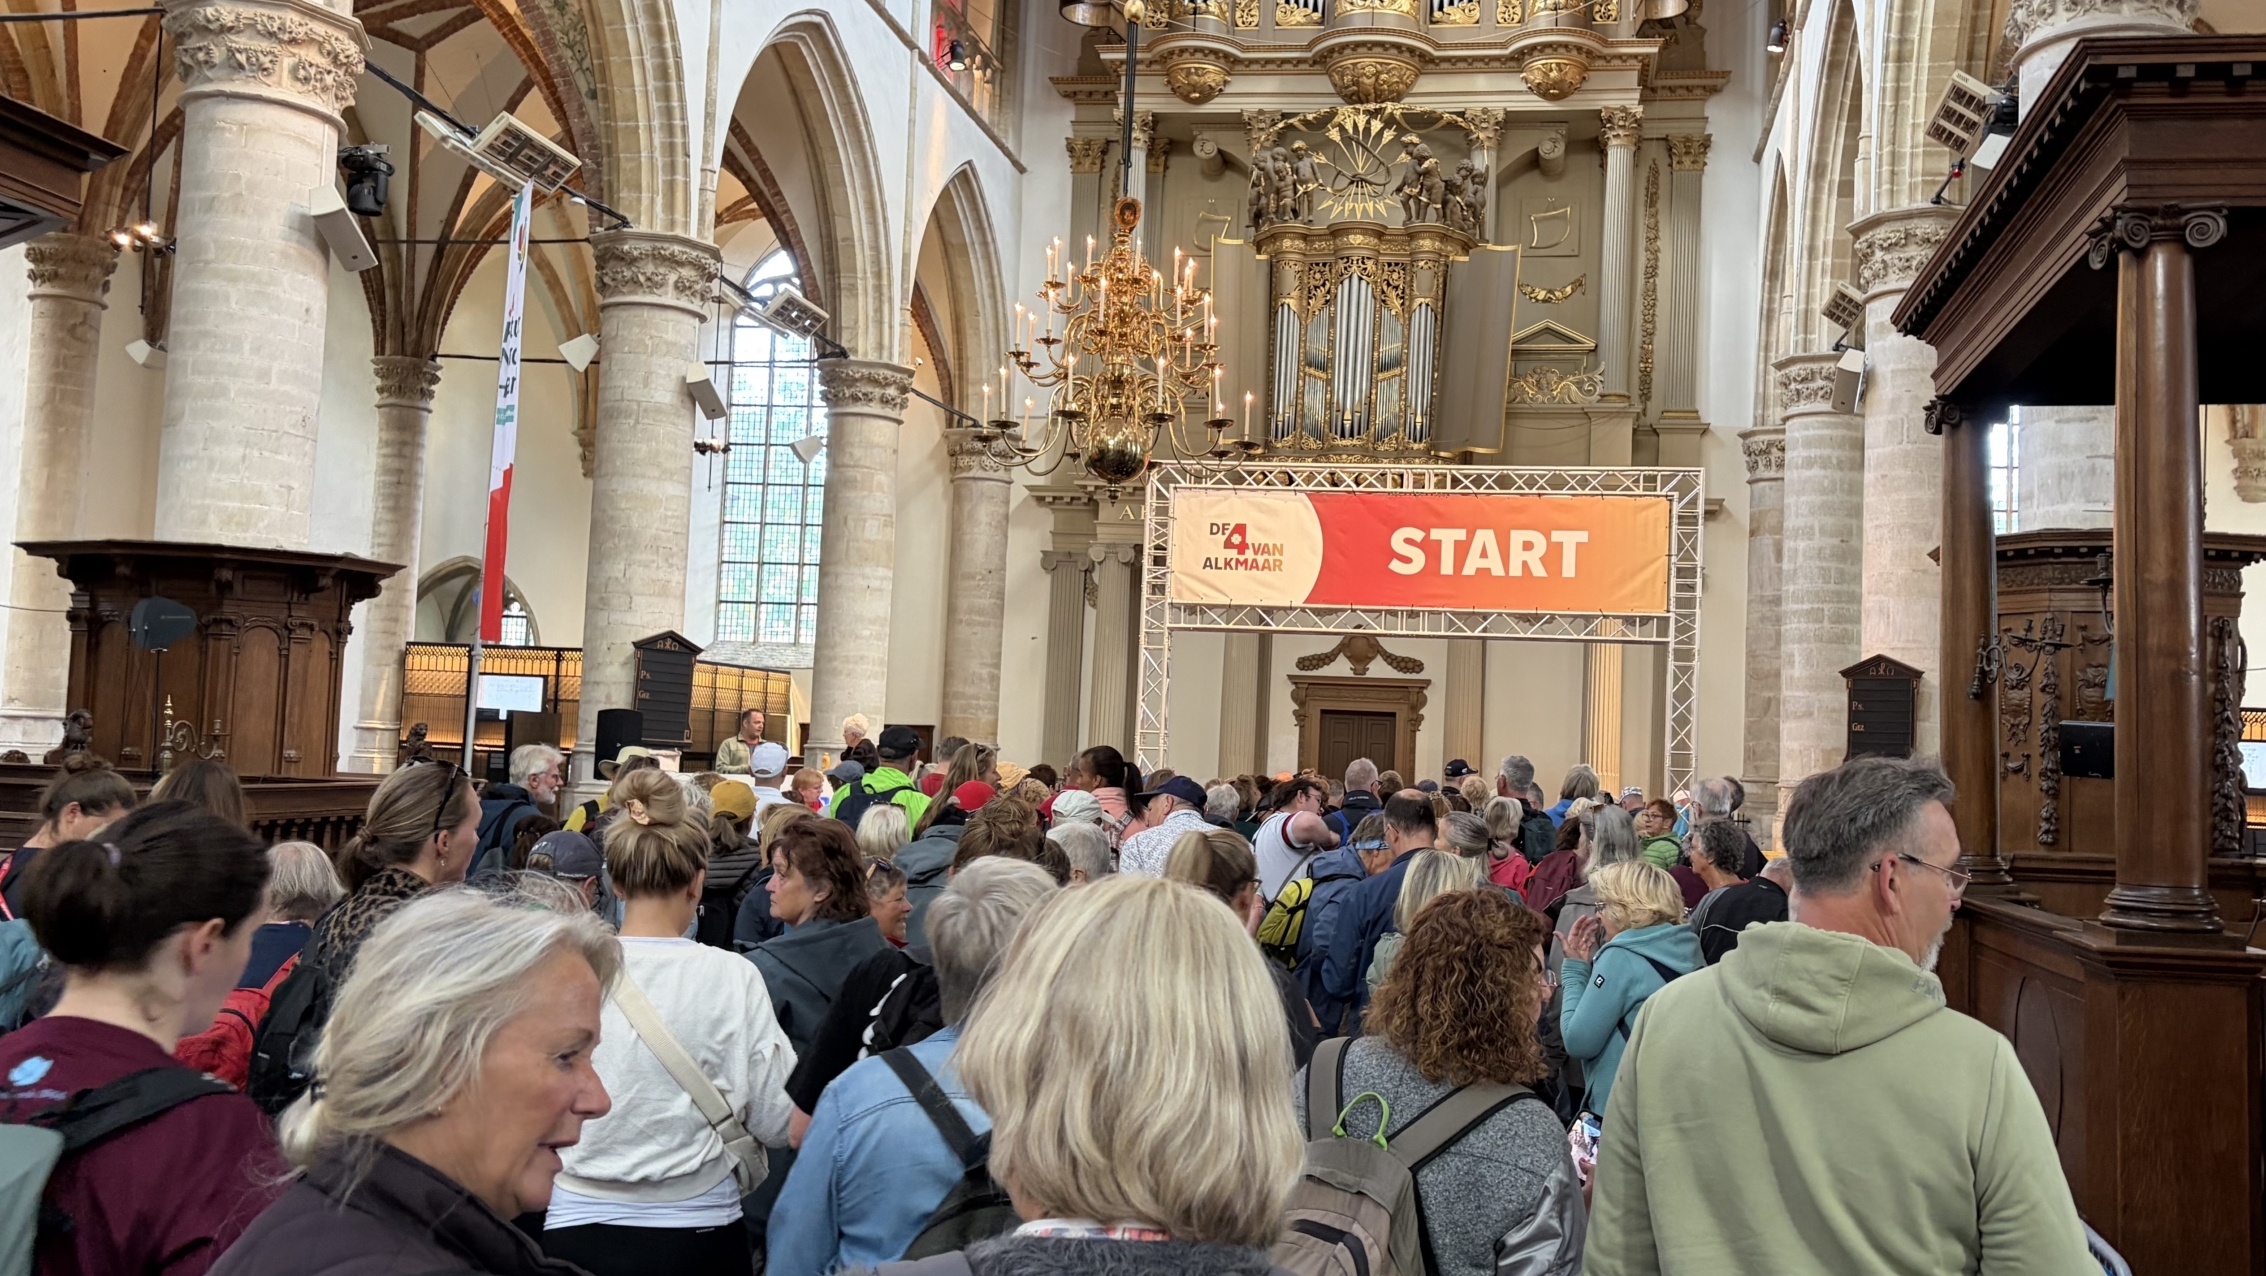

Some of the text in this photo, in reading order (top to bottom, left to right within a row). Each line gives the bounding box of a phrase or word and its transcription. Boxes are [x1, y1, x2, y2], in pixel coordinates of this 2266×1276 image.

[1223, 523, 1250, 556] 4
[1251, 542, 1284, 557] VAN
[1387, 526, 1589, 578] START
[1202, 556, 1283, 572] ALKMAAR
